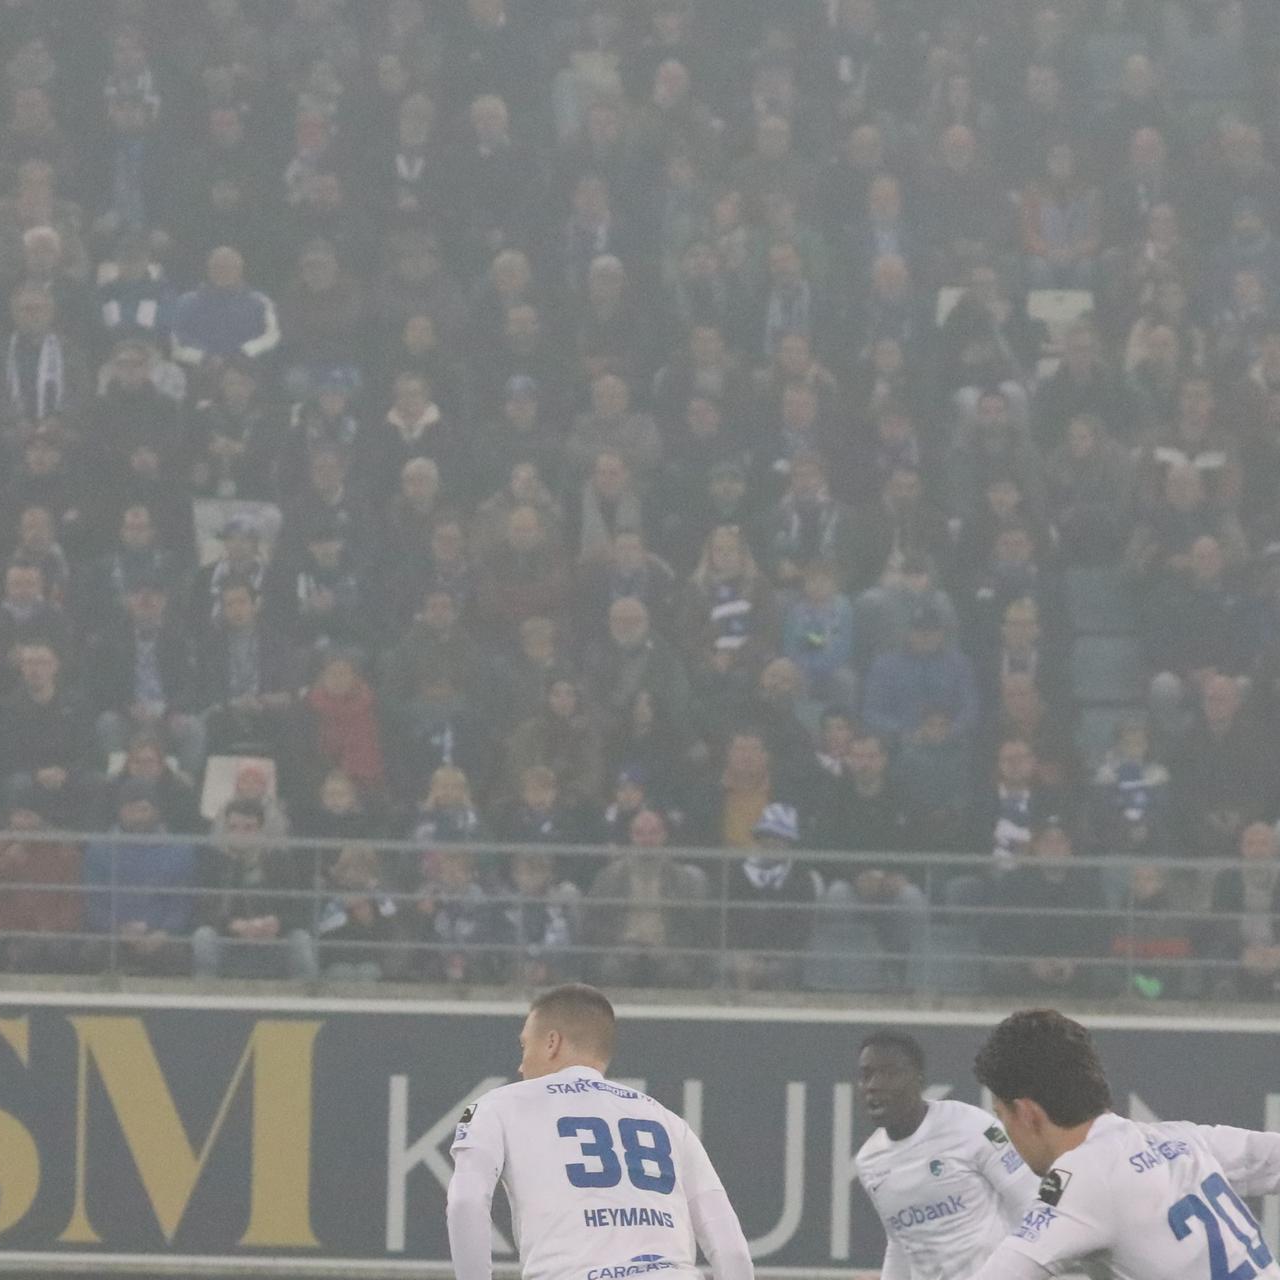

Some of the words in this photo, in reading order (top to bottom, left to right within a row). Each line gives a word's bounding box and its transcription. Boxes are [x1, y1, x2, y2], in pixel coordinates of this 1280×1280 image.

[546, 1078, 592, 1095] STAR
[557, 1116, 676, 1195] 38
[583, 1206, 675, 1229] HEYMANS
